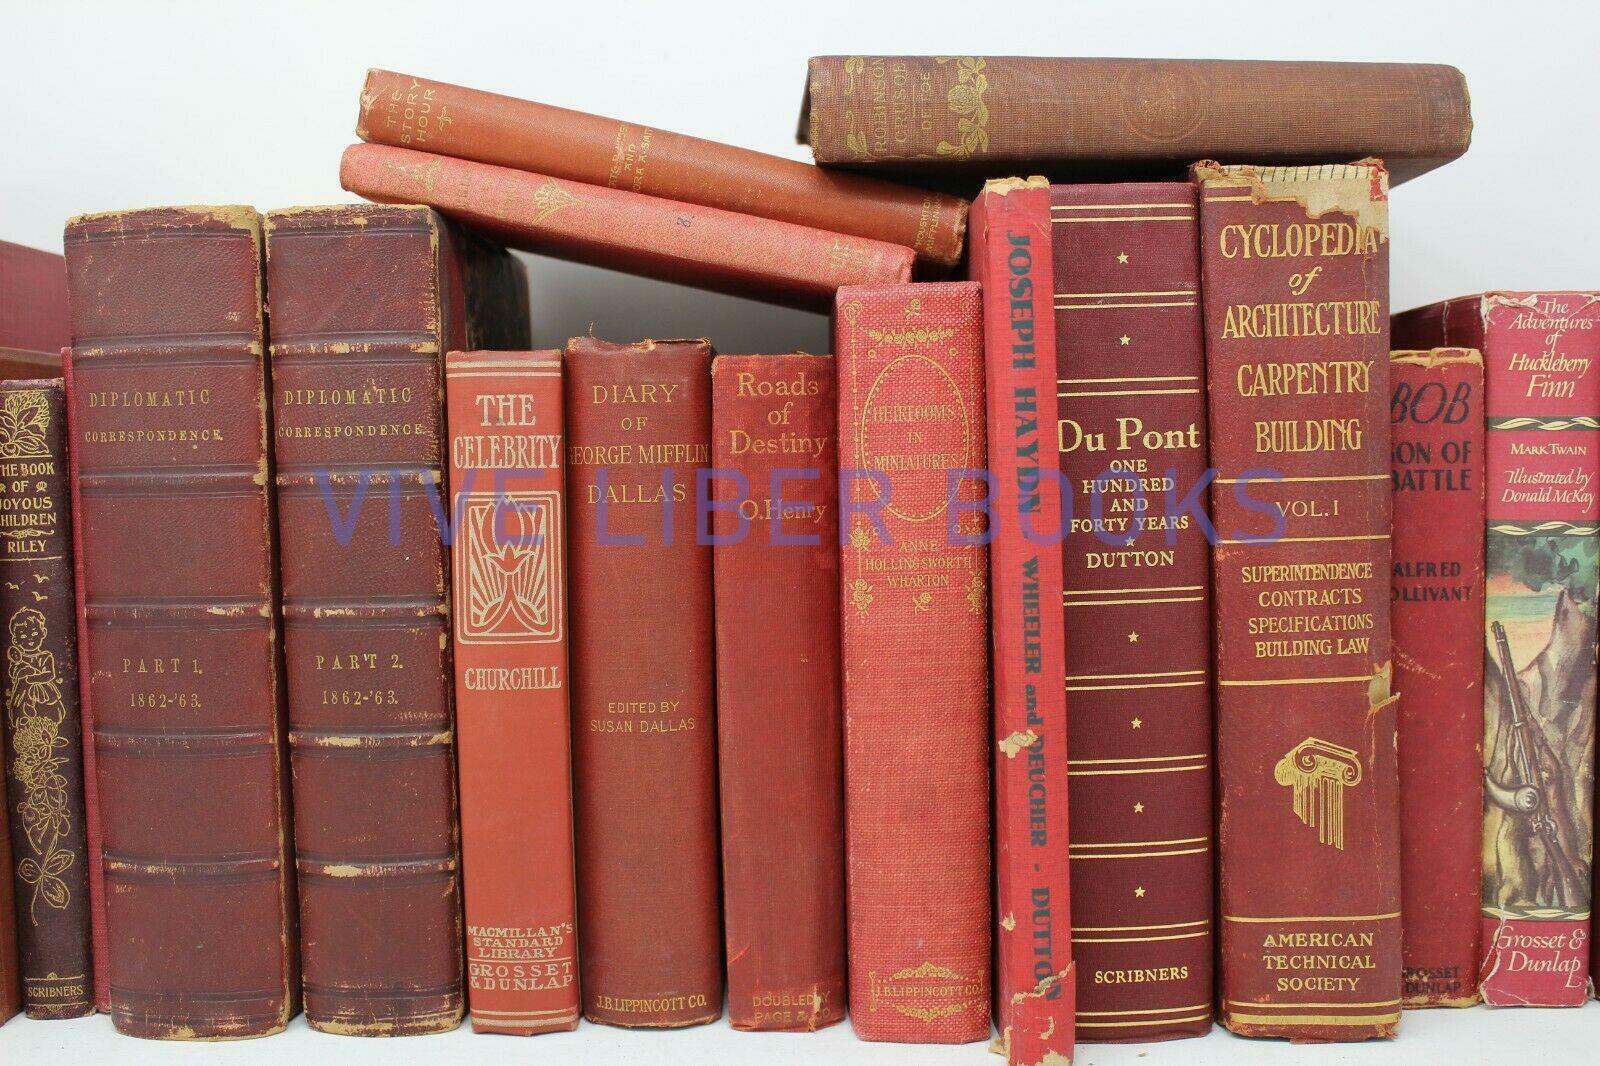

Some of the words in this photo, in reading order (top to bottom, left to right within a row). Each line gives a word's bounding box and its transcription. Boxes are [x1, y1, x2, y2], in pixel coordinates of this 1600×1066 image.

[400, 79, 421, 144] STORY
[416, 88, 436, 142] HOUR
[624, 143, 636, 171] AND
[1220, 223, 1378, 258] CYCLOPEDIA
[1288, 266, 1322, 296] of
[1006, 229, 1036, 369] JOSEPH
[1541, 297, 1570, 314] The
[1221, 300, 1382, 339] ARCHITECTURE
[1508, 311, 1594, 330] Adventures
[1545, 328, 1566, 357] of
[1508, 350, 1593, 379] Huckleberry
[736, 372, 819, 397] Roads
[1236, 360, 1375, 397] CARPENTRY
[1526, 374, 1576, 398] Finn
[89, 389, 210, 408] DIPLOMATIC
[284, 387, 412, 406] DIPLOMATIC
[592, 384, 679, 404] DIARY
[1391, 381, 1472, 424] BOB
[475, 393, 537, 427] THE
[767, 401, 794, 425] of
[621, 416, 648, 431] OF
[729, 430, 828, 458] Destiny
[907, 431, 924, 444] IN
[1058, 418, 1107, 452] Du
[1116, 417, 1200, 450] Pont
[1254, 418, 1363, 453] BUILDING
[453, 434, 562, 469] CELEBRITY
[638, 443, 709, 464] MIFFLIN
[1014, 386, 1041, 514] HAYDN
[1391, 440, 1432, 465] ON
[1441, 440, 1472, 464] OF
[0, 463, 18, 477] HE
[20, 462, 55, 476] BOOK
[874, 453, 960, 471] MINIATURES
[1109, 459, 1148, 474] ONE
[12, 480, 29, 493] OF
[1082, 477, 1175, 494] HUNDRED
[1503, 467, 1575, 484] Illustrated
[1575, 466, 1596, 492] by
[587, 484, 687, 504] DALLAS
[1501, 486, 1554, 503] Donald
[1553, 488, 1595, 514] McKay
[1109, 498, 1149, 512] AND
[0, 512, 57, 527] HILDREN
[1070, 516, 1129, 533] FORTY
[1135, 515, 1189, 531] YEARS
[7, 540, 47, 553] RILEY
[900, 540, 938, 552] ANNE
[866, 556, 972, 571] HOLLINGSWORTH
[1085, 550, 1175, 569] DUTTON
[1241, 562, 1373, 583] SUPERINTENDENCE
[1393, 562, 1461, 577] ALFRED
[887, 574, 950, 588] WHARTON
[1258, 588, 1362, 607] CONTRACTS
[1022, 555, 1042, 674] WHEELER
[1248, 613, 1374, 634] SPECIFICATIONS
[1255, 639, 1333, 658] BUILDING
[1336, 637, 1370, 655] LAW
[122, 658, 180, 673] PART
[316, 653, 377, 669] PART
[464, 665, 562, 690] CHURCHILL
[608, 702, 656, 713] EDITED
[660, 701, 680, 713] BY
[1024, 683, 1045, 726] and
[590, 719, 632, 733] SUSAN
[640, 717, 695, 733] DALLAS
[1027, 734, 1048, 847] DEUCHER
[467, 922, 573, 938] MACMILLAN'S
[1262, 932, 1374, 947] AMERICAN
[1497, 925, 1566, 949] Grosset
[1568, 928, 1586, 950] &
[473, 936, 564, 948] STANDARD
[478, 947, 557, 959] LIBRARY
[1262, 955, 1376, 970] TECHNICAL
[469, 961, 572, 977] GROSSET
[1094, 966, 1188, 984] SCRIBNERS
[1506, 950, 1582, 988] Dunlap
[27, 984, 84, 997] SCRIBNERS
[483, 974, 573, 991] DUNLAP
[1276, 977, 1360, 991] SOCIETY
[688, 993, 707, 1008] CO.
[755, 1011, 791, 1023] PAGE
